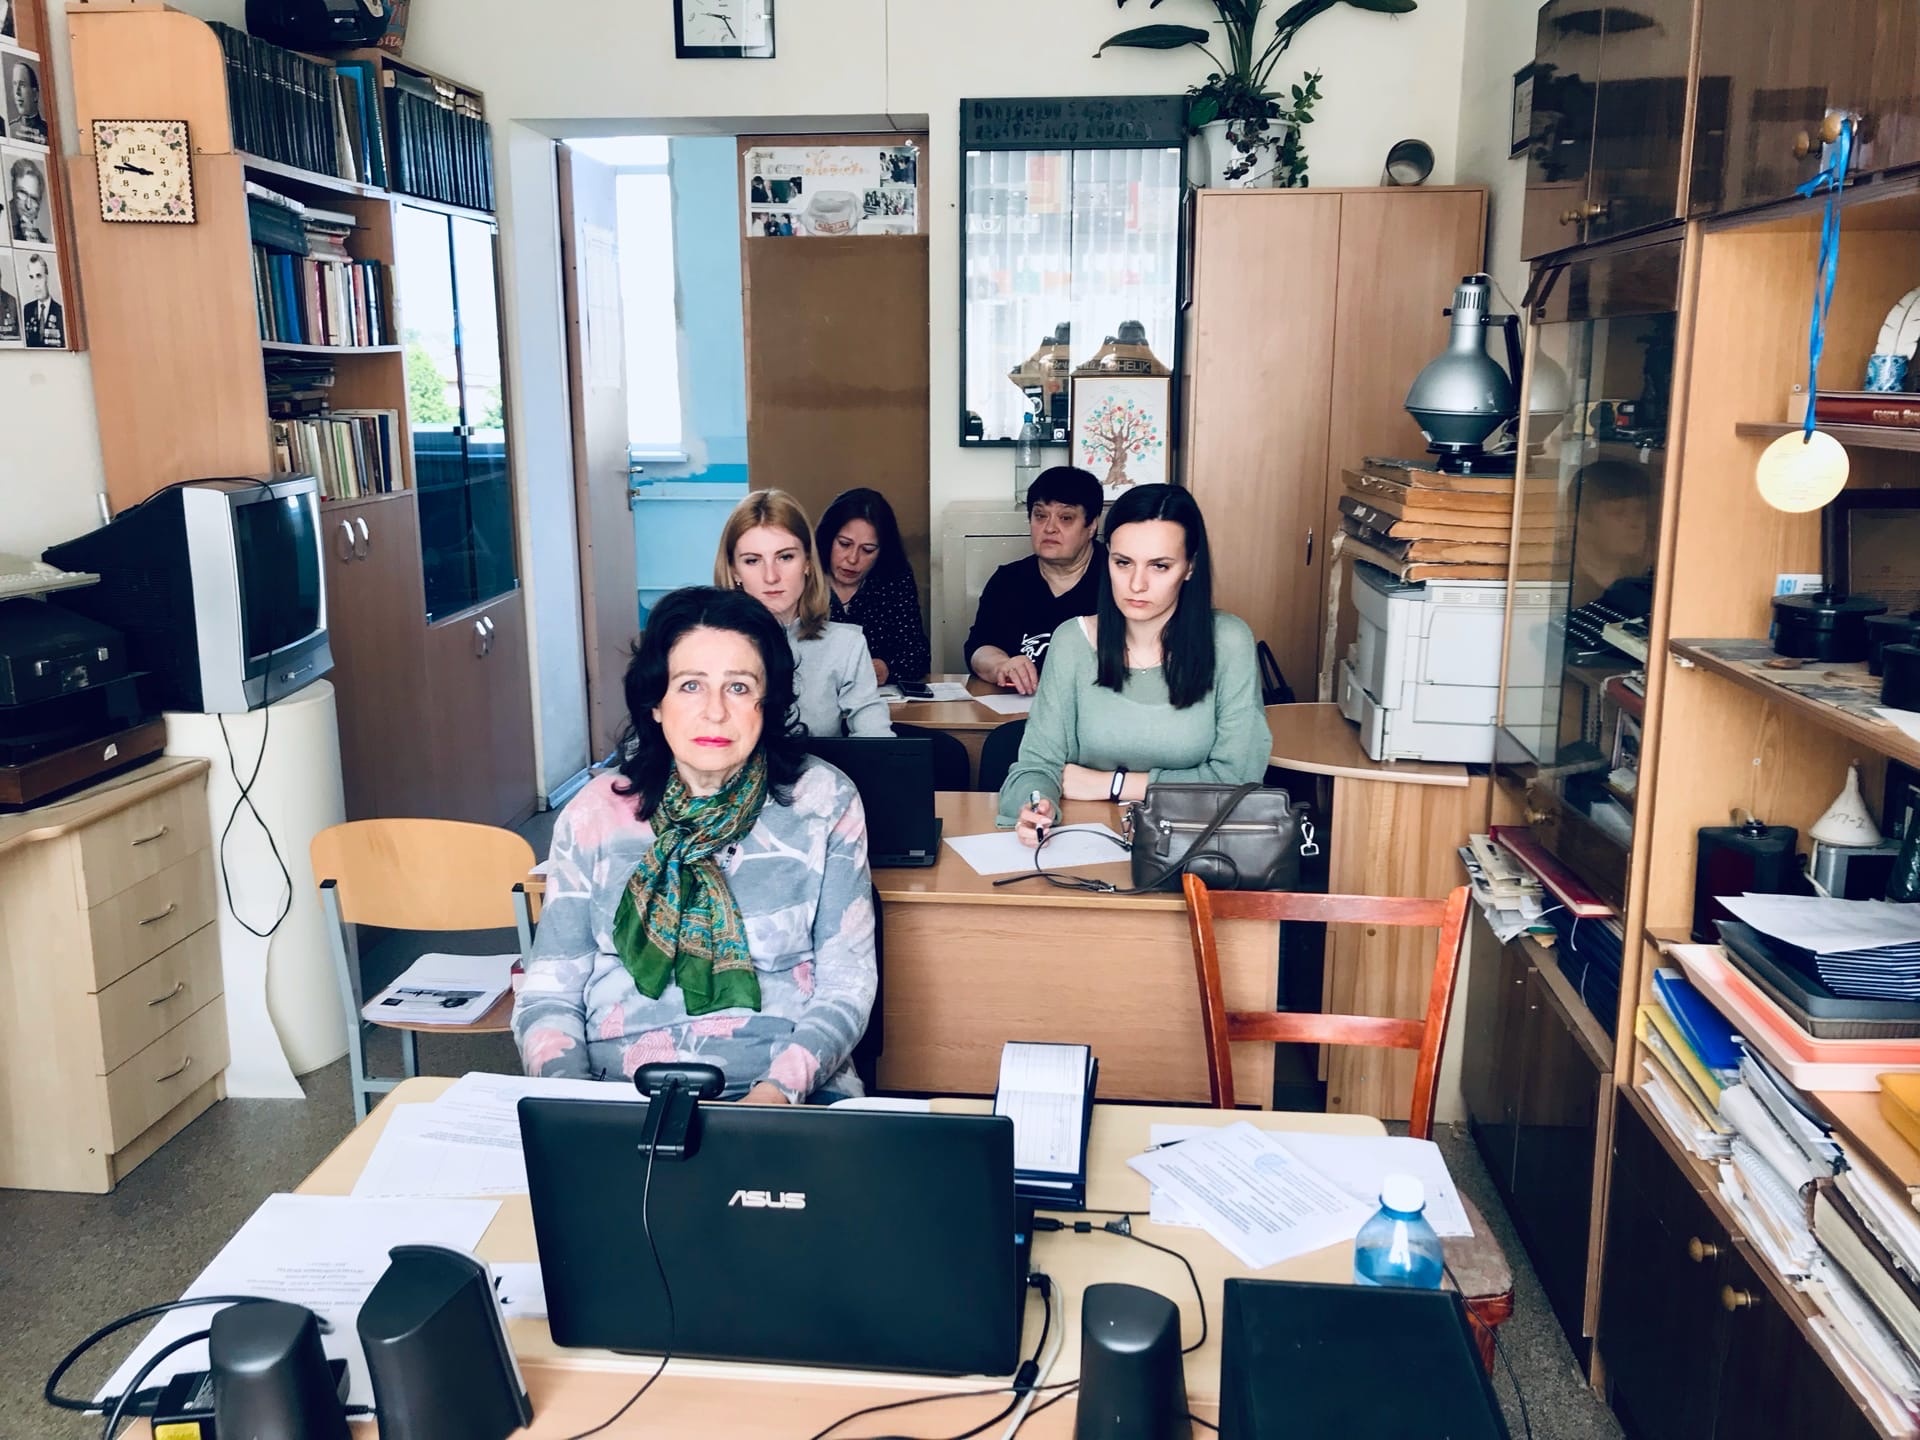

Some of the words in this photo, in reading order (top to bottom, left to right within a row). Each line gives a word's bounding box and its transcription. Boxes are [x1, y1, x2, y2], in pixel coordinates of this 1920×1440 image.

[123, 179, 129, 187] 8
[154, 189, 160, 197] 5
[728, 1190, 806, 1209] ASUS
